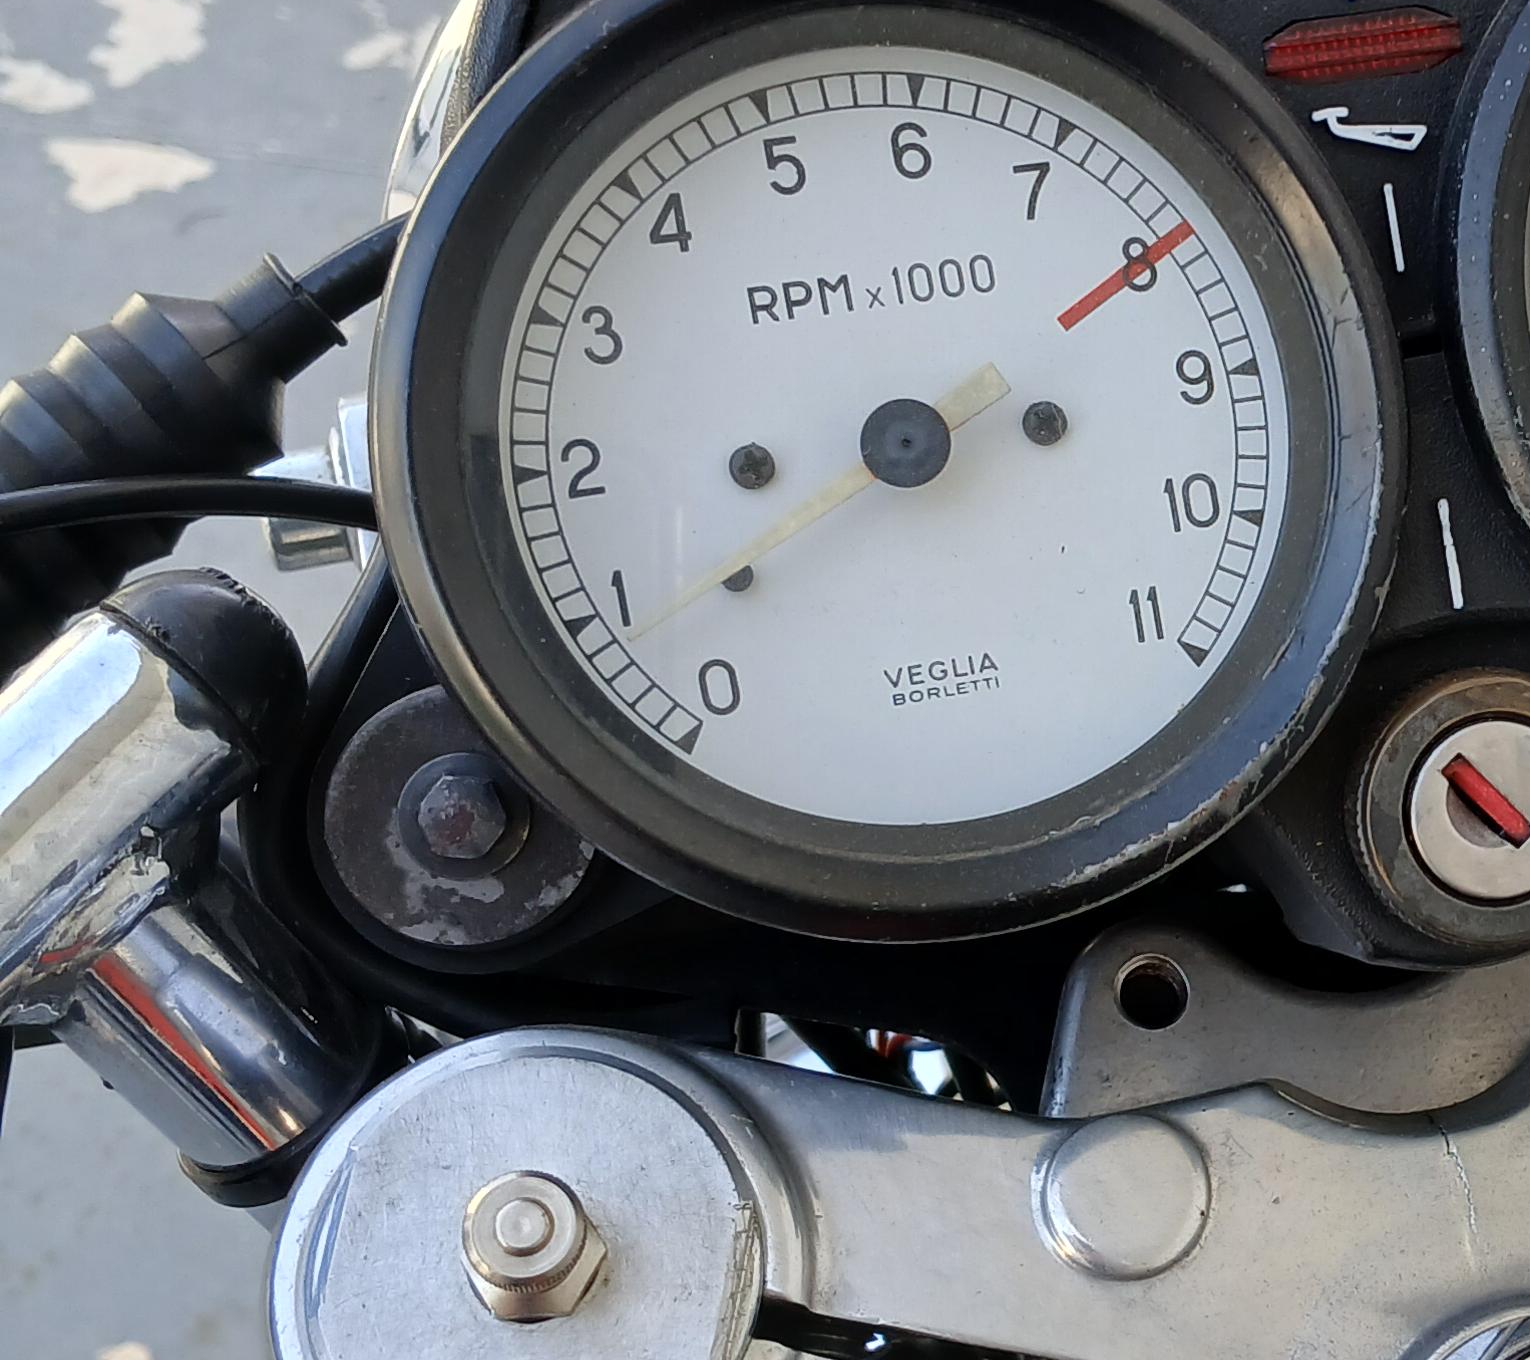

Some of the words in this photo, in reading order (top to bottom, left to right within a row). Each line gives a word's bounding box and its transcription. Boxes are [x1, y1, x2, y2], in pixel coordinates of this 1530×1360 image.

[763, 135, 806, 196] 5
[890, 122, 932, 180] 6
[1012, 161, 1051, 221] 7
[649, 193, 693, 253] 4
[1122, 237, 1158, 292] 8
[746, 274, 855, 325] RPM
[581, 305, 623, 365] 3
[1175, 349, 1215, 405] 9
[560, 438, 606, 500] 2
[1163, 473, 1220, 533] 10
[610, 570, 632, 628] 1
[1128, 585, 1165, 643] 11
[698, 658, 741, 717] 0
[883, 651, 1000, 689] VEGLIA
[891, 675, 1000, 707] BORLETTI
